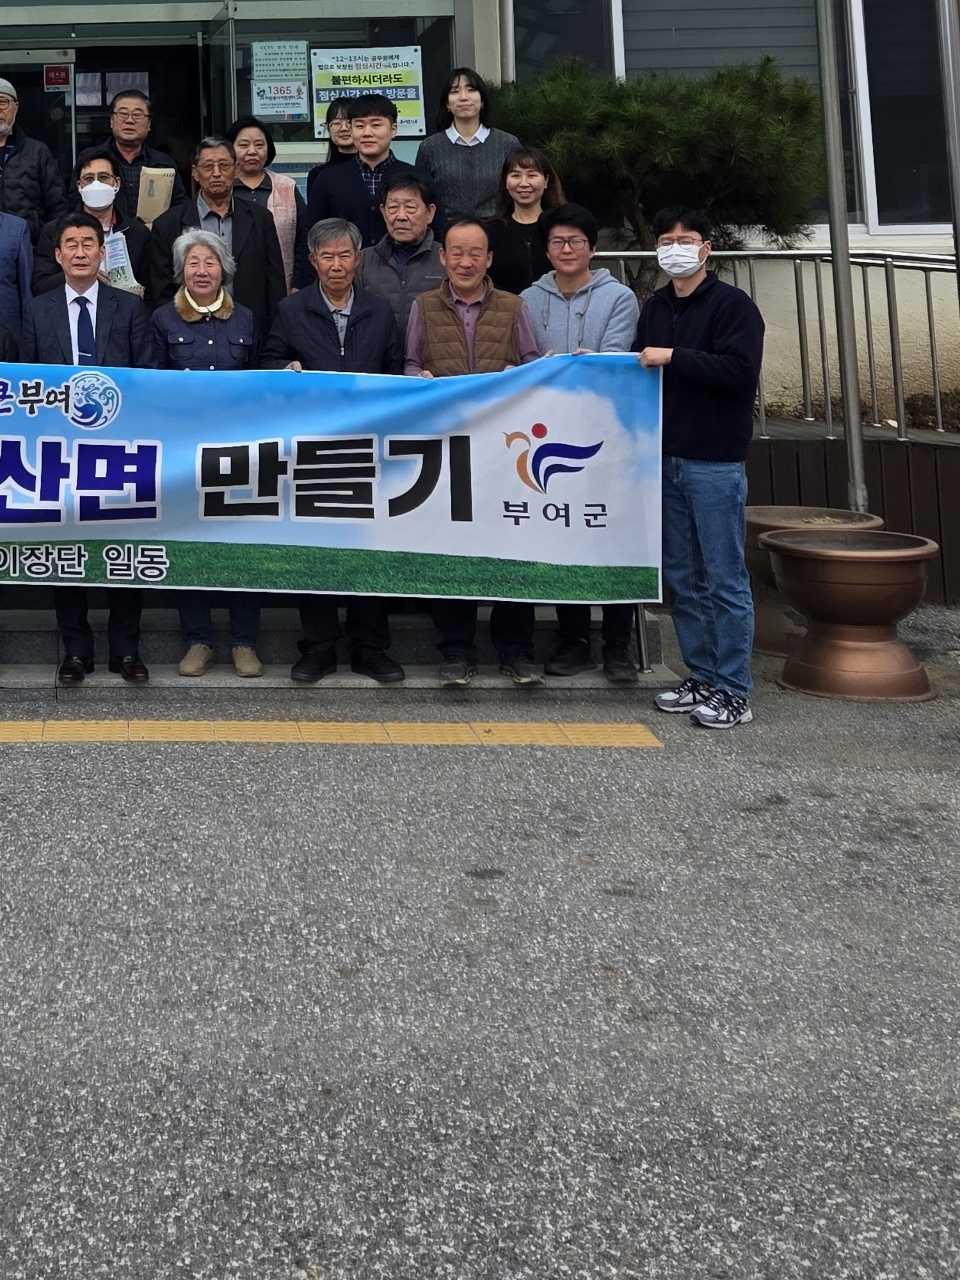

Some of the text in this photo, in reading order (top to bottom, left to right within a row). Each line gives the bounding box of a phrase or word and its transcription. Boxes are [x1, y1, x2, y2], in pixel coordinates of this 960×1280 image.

[268, 85, 292, 95] 1365
[331, 73, 404, 86] 불편하시더라도
[386, 87, 417, 99] 방문을
[18, 381, 71, 415] 부여
[200, 434, 473, 523] 만들기
[502, 500, 608, 528] 부여군
[104, 546, 170, 579] 일동
